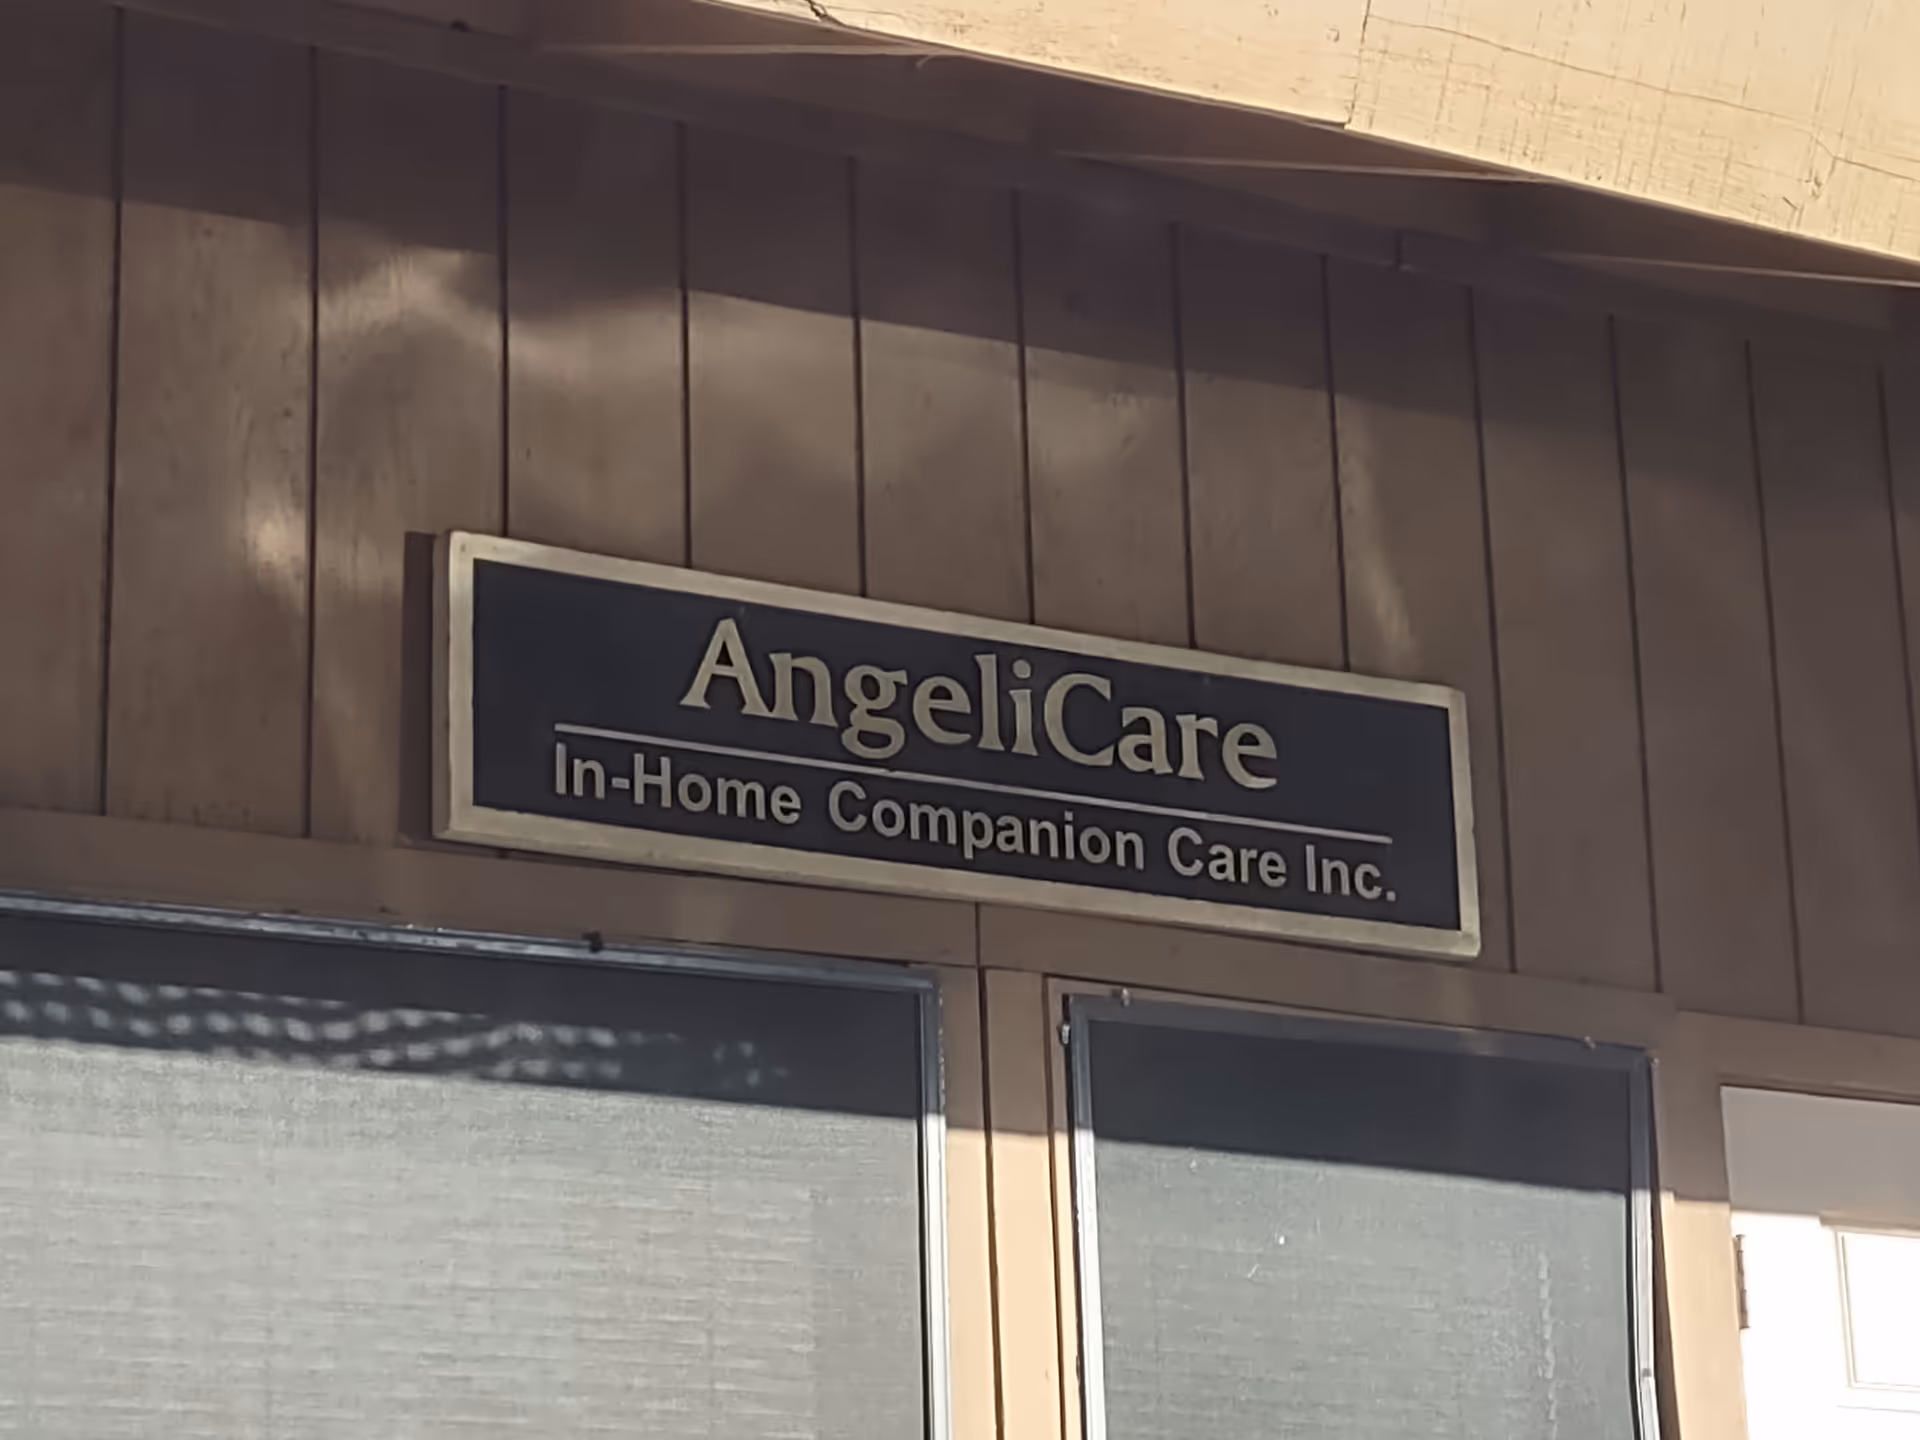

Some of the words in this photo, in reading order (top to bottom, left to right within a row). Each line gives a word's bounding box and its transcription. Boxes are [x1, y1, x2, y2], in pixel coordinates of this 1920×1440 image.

[680, 617, 1278, 790] AngeliCare
[554, 742, 802, 826] In-Home
[828, 780, 1145, 870] Companion
[1167, 826, 1288, 889] Care
[1305, 844, 1398, 902] Inc.
